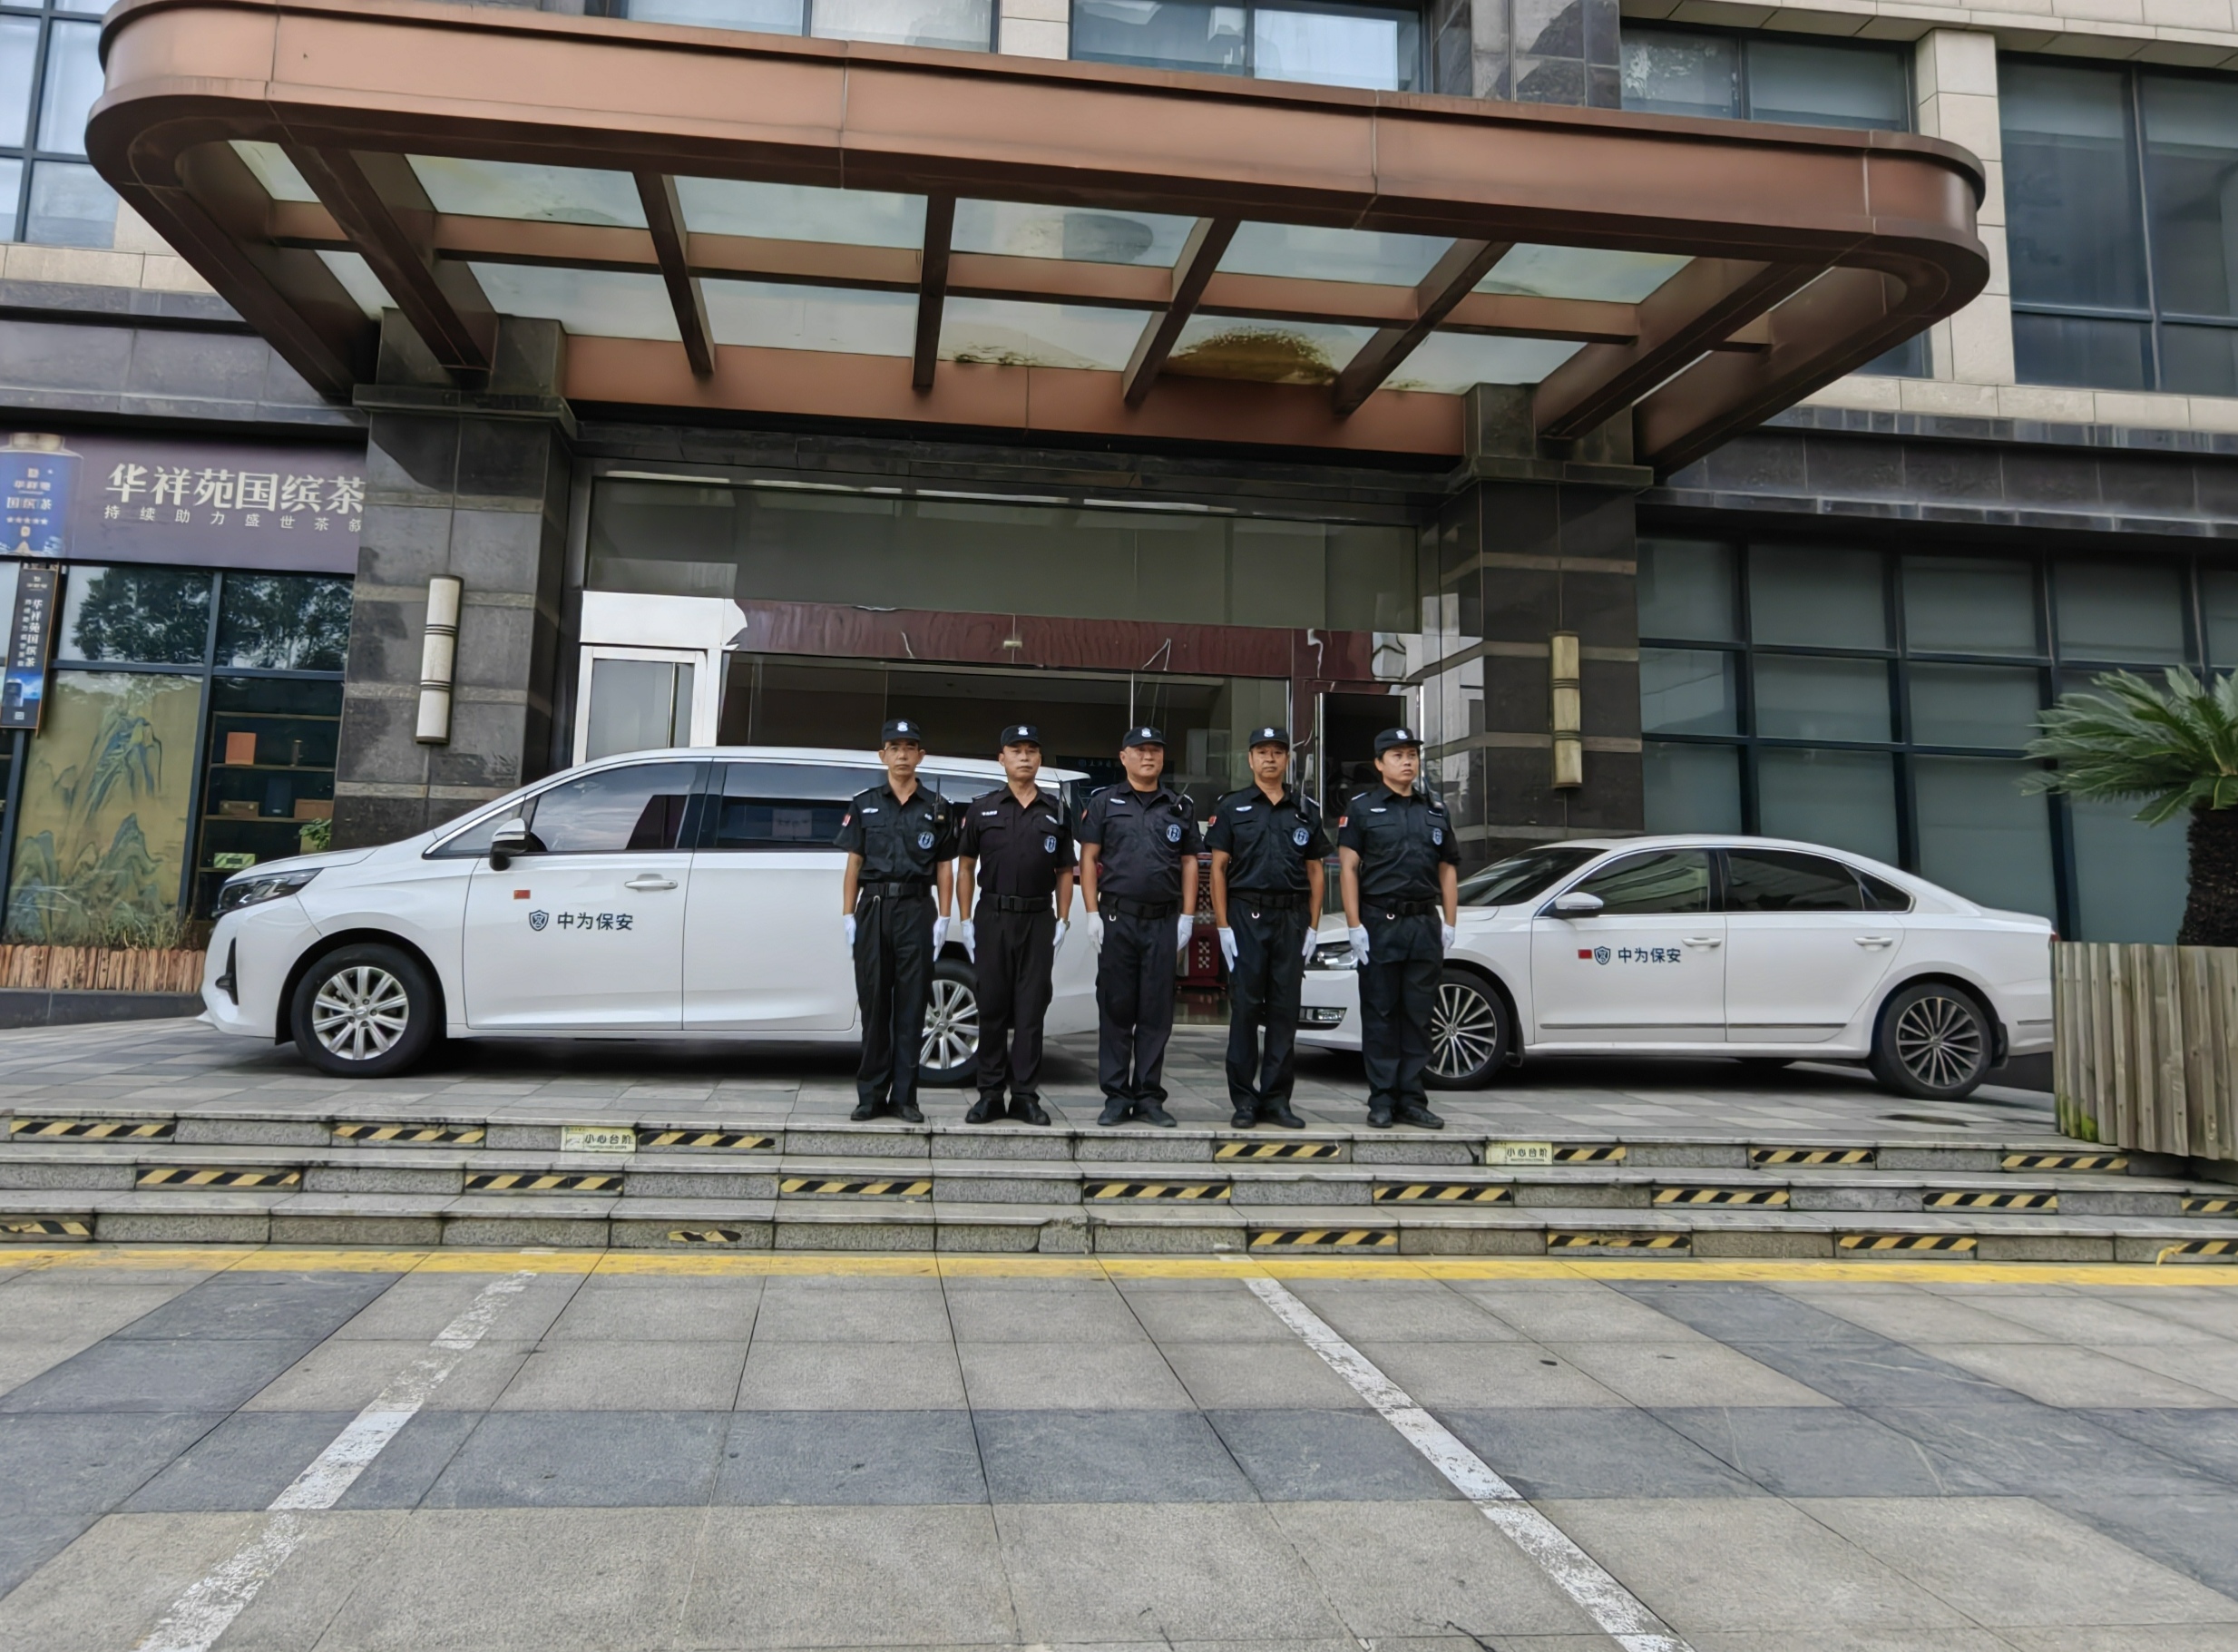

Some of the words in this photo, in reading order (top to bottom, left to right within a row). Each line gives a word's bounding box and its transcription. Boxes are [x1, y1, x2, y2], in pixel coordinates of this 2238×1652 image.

[105, 463, 365, 515] 华祥苑国缤茶
[557, 912, 633, 931] 中为保安
[1617, 947, 1682, 963] 中为保安
[584, 1134, 632, 1145] 小心台阶
[1506, 1148, 1548, 1158] 小心台阶
